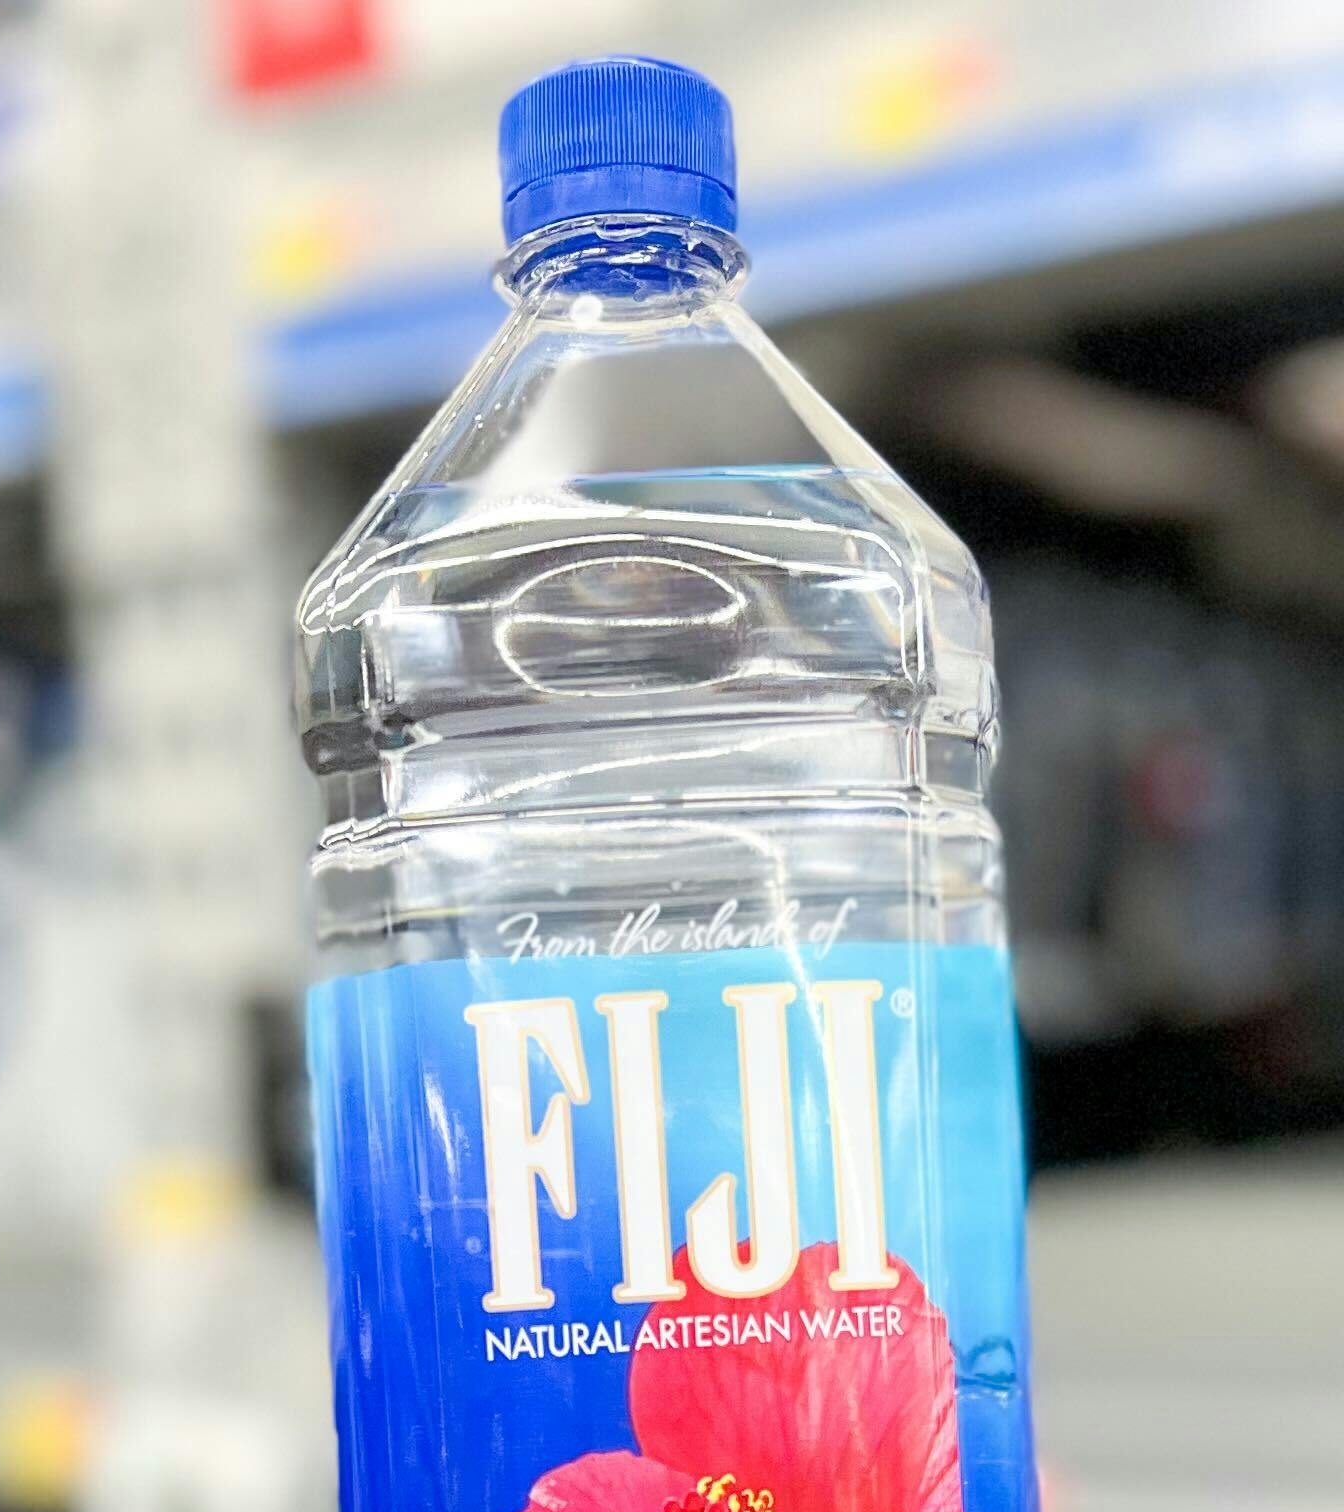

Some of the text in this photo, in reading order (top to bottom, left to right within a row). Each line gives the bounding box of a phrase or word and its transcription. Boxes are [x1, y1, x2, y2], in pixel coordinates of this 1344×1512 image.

[497, 911, 596, 965] From
[609, 903, 671, 958] the
[810, 897, 857, 959] of
[464, 981, 901, 1313] FIJI
[485, 1305, 905, 1361] NATURAL ARTESIAN WATER
